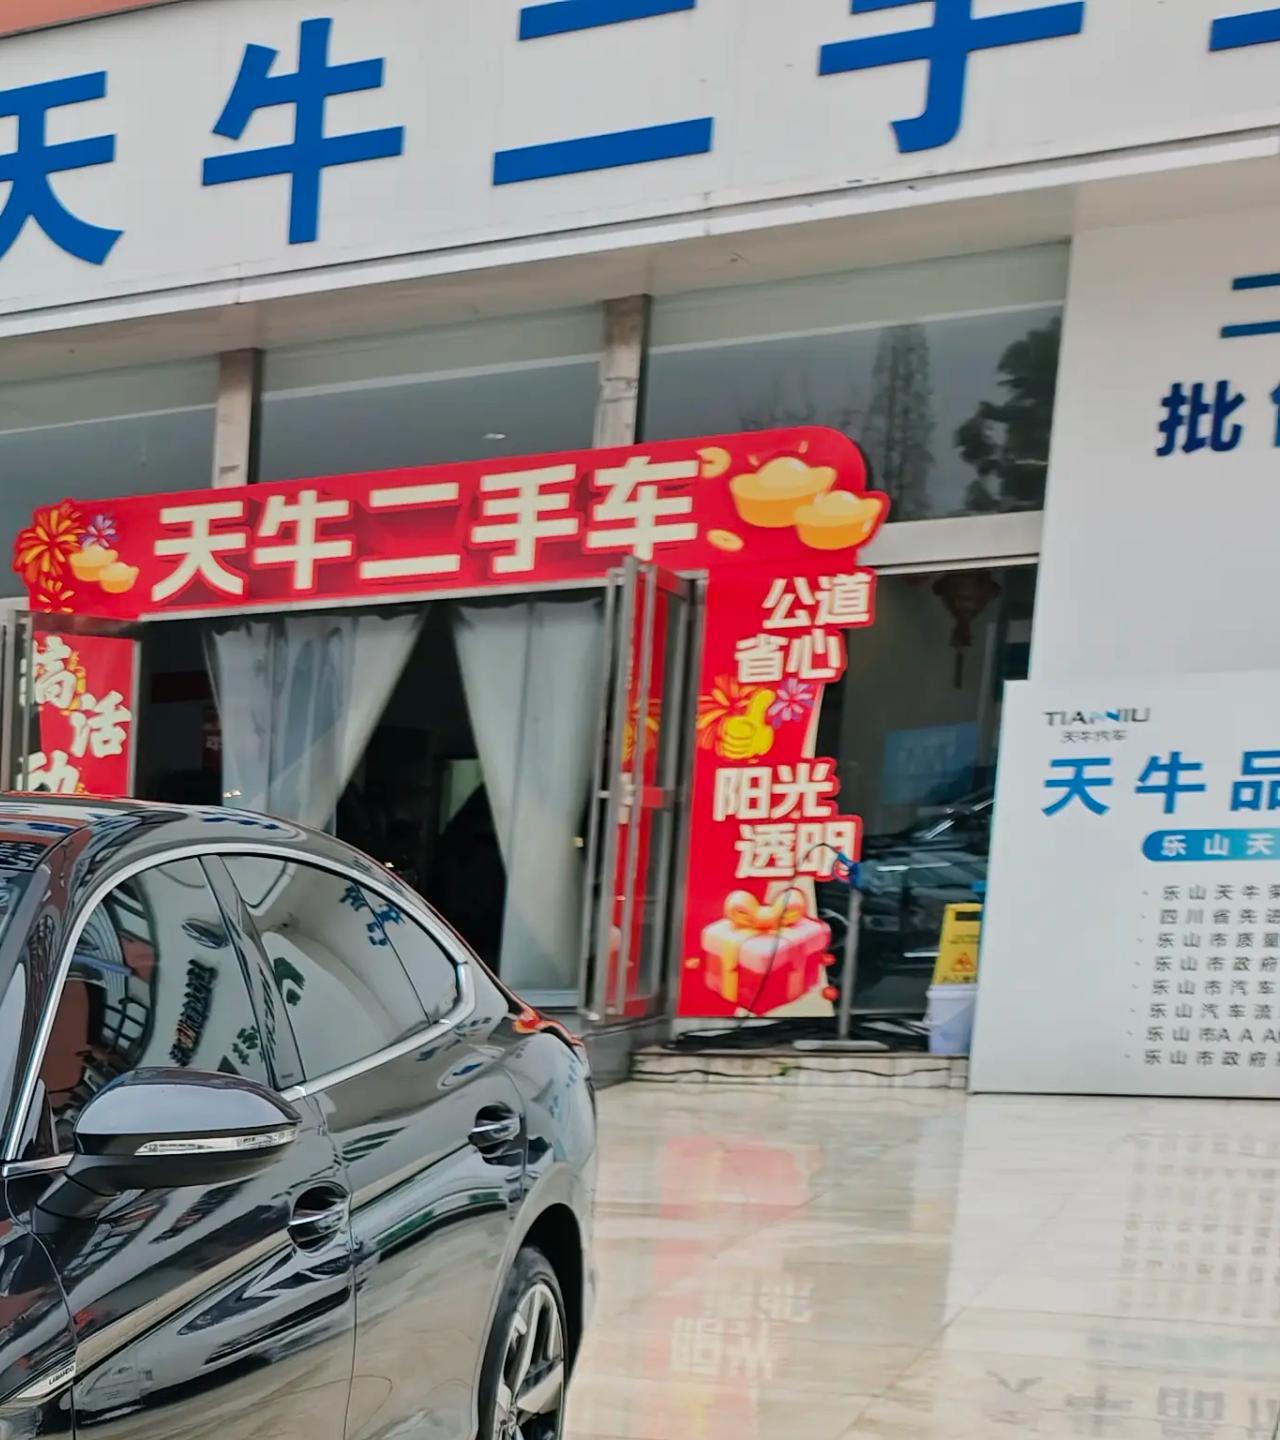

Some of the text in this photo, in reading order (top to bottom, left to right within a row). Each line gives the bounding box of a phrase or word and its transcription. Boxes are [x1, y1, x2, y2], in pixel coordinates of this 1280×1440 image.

[1156, 379, 1280, 457] 批
[152, 456, 698, 602] 天牛二手车
[762, 573, 872, 629] 公道
[735, 629, 840, 683] 省心
[713, 763, 834, 821] 阳光
[1041, 750, 1280, 817] 天牛品
[735, 822, 855, 878] 透明
[1160, 832, 1276, 857] 乐山天
[1144, 1049, 1280, 1068] 乐山市政府
[1146, 1025, 1280, 1043] 乐山市AAA
